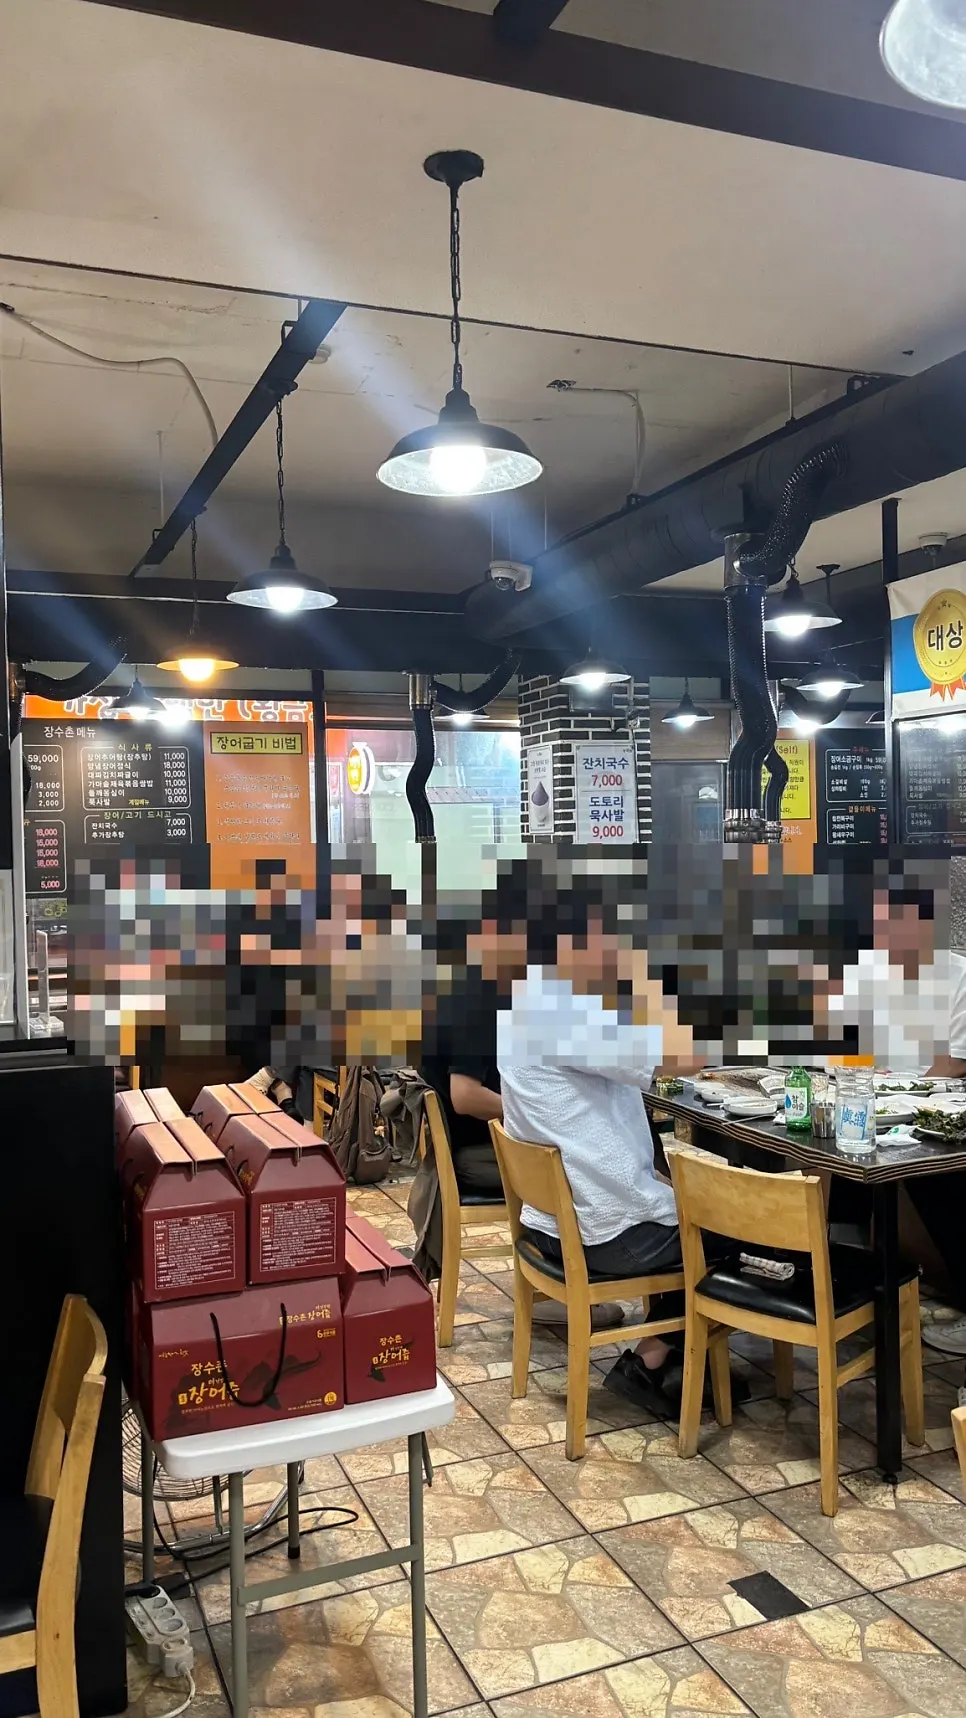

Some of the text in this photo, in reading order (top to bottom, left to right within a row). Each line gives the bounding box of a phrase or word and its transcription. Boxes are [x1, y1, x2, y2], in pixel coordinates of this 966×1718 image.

[928, 620, 963, 650] 대상
[44, 726, 96, 738] 장수촌 메뉴
[217, 736, 297, 750] 장어굽기 비법
[27, 754, 59, 763] 59,000
[164, 752, 185, 760] 11,000
[582, 757, 630, 770] 잔치국수
[164, 770, 186, 778] 10,000
[36, 782, 60, 790] 18,000
[592, 775, 622, 788] 7,000
[164, 788, 186, 796] 10,000
[168, 796, 188, 804] 9,000
[589, 796, 624, 808] 도토리
[104, 810, 172, 820] 장어/고기 드시고
[589, 810, 624, 822] 묵사발
[92, 818, 186, 830] 잔치국수 7,000
[166, 829, 186, 837] 3,000
[592, 826, 624, 839] 9,000
[40, 880, 60, 889] 5,000
